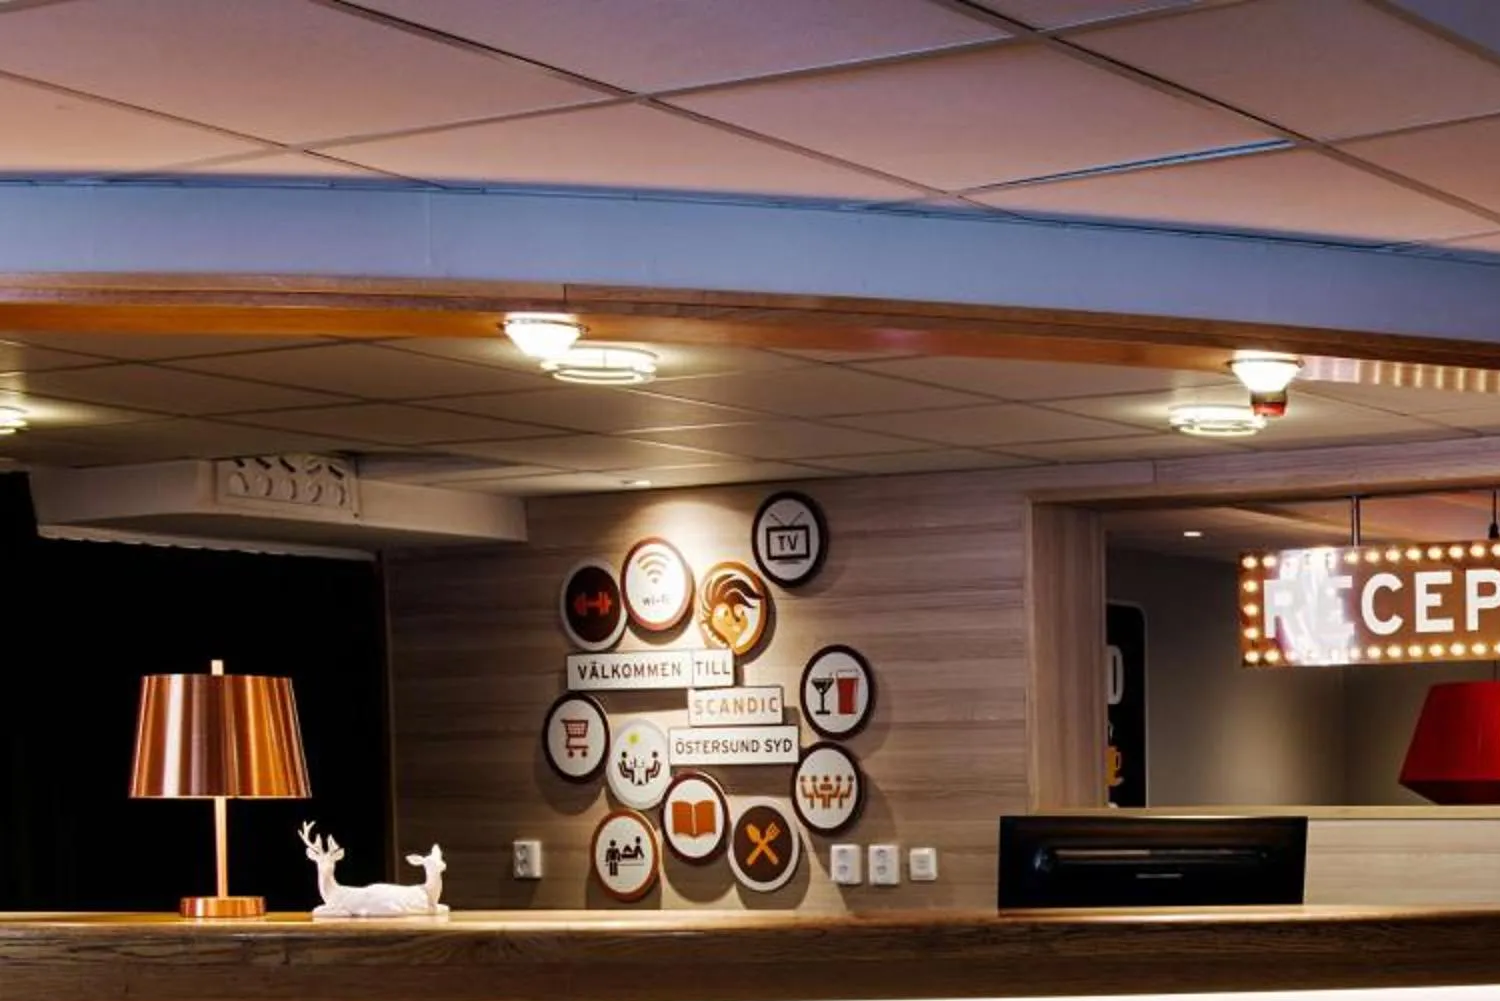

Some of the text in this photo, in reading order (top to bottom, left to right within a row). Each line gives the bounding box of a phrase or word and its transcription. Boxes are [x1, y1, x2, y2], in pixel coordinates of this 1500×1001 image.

[777, 535, 799, 551] TV
[577, 661, 731, 680] VÄLKOMMEN TILL
[694, 696, 779, 715] SCANDIC
[675, 738, 793, 754] ÖSTERSUND SYD
